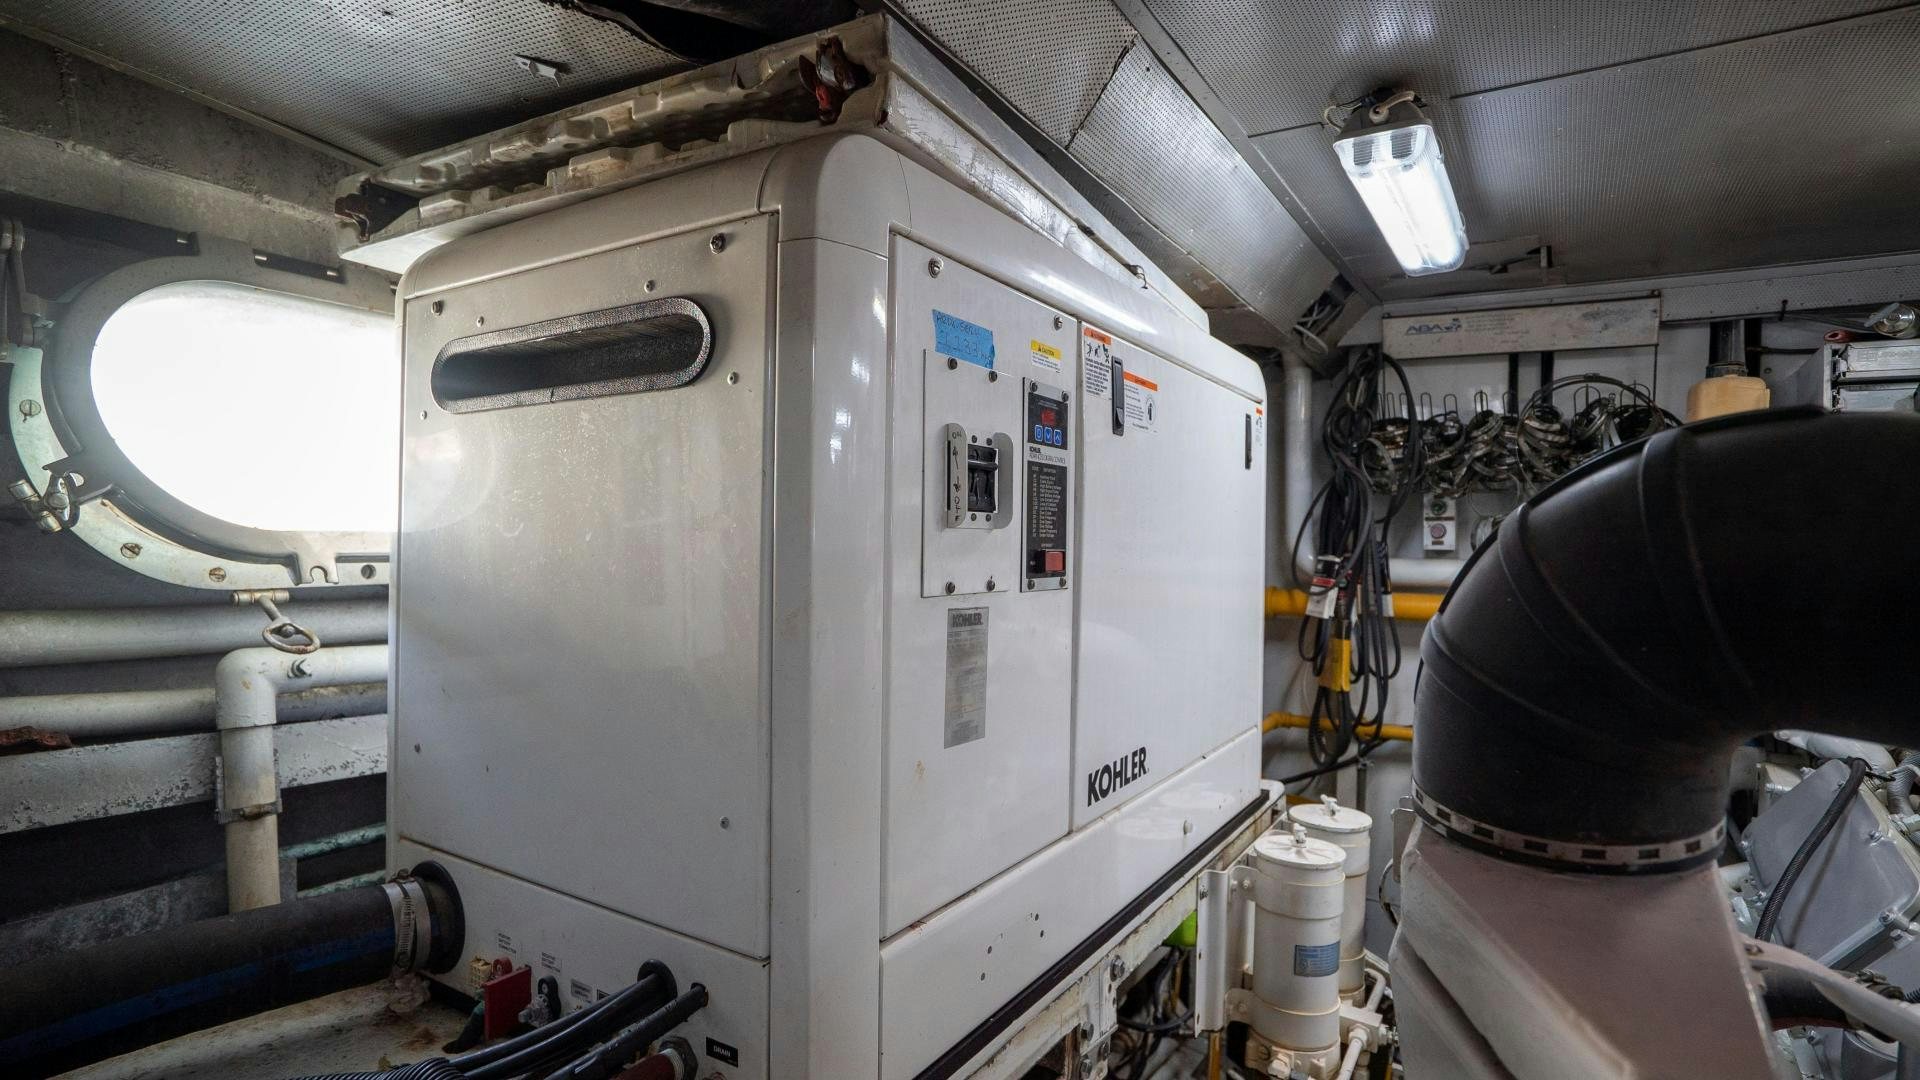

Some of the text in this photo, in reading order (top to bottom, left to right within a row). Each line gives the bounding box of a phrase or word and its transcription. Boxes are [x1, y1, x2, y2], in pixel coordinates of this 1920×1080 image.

[952, 612, 983, 628] KOHLER
[1087, 746, 1147, 807] KOHLER
[713, 1045, 731, 1057] DRAIN
